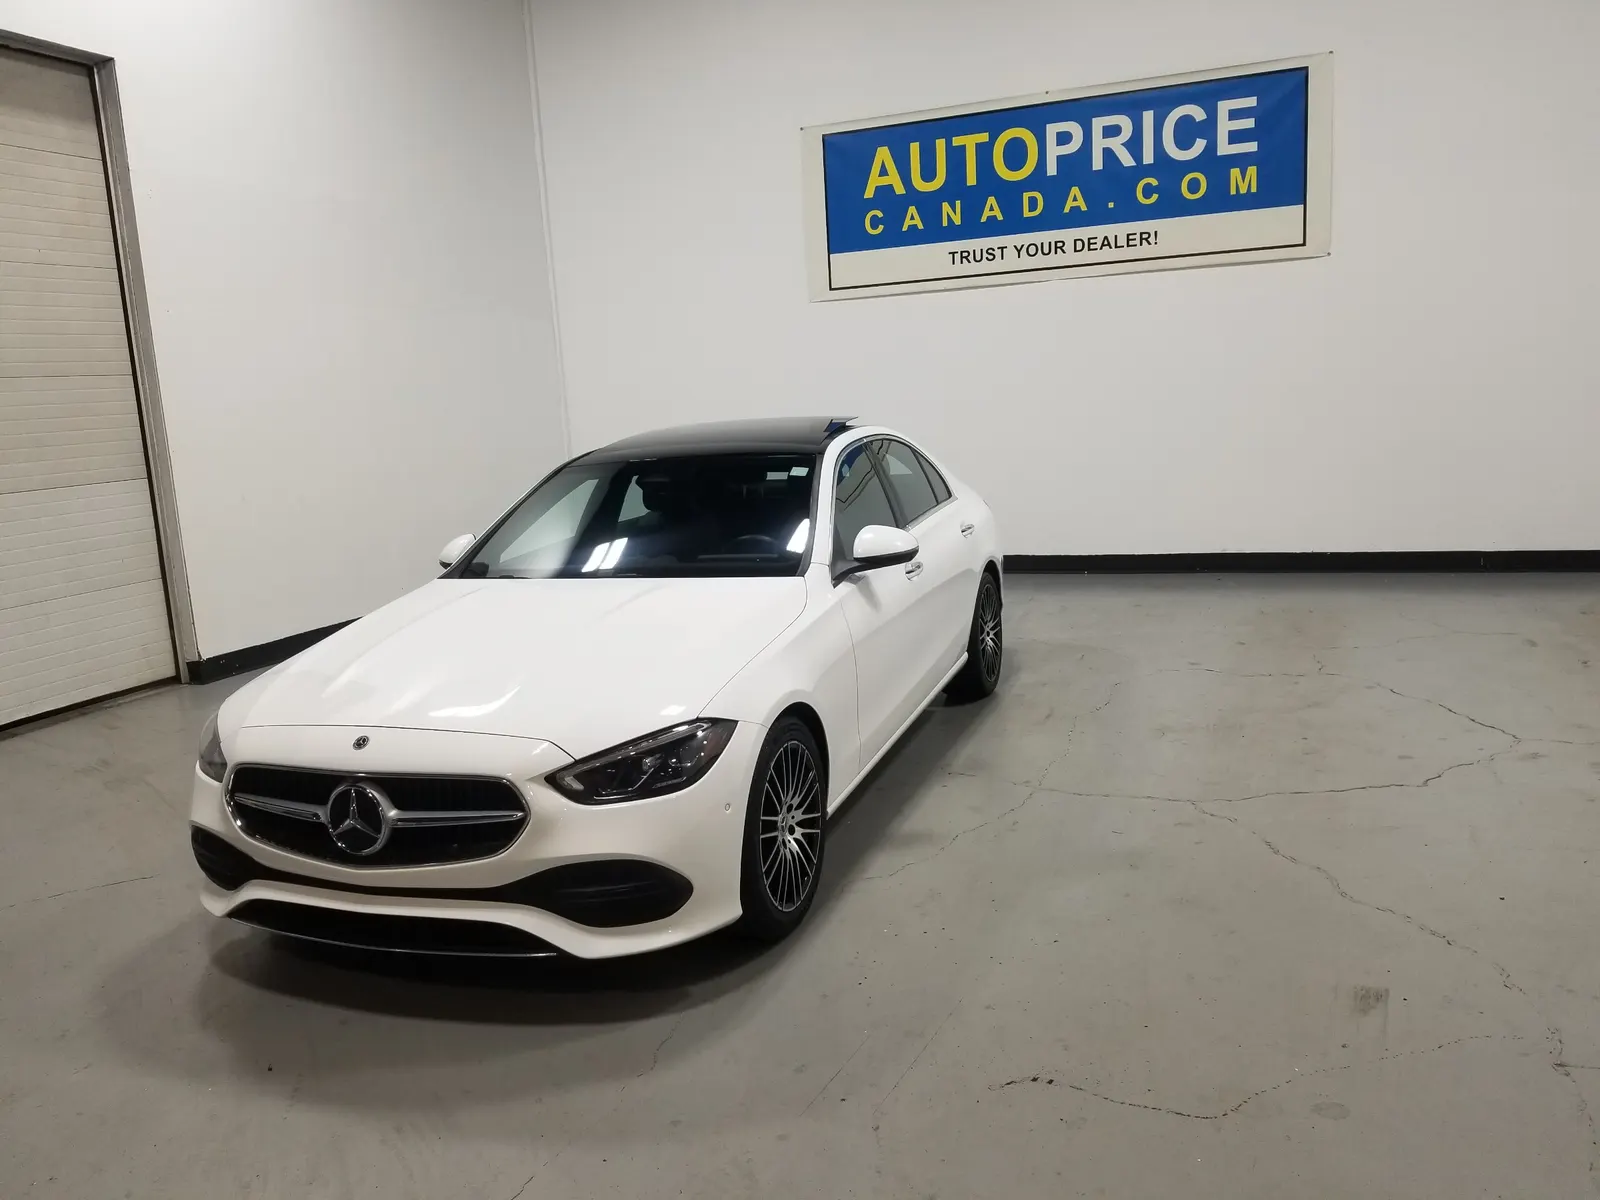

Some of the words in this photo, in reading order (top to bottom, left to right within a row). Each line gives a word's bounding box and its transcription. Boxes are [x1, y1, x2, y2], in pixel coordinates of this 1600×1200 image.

[864, 96, 1258, 198] AUTOPRICE
[864, 166, 1258, 235] CANADA.COM
[949, 246, 1008, 265] TRUST
[1014, 240, 1066, 259] YOUR
[1073, 231, 1159, 253] DEALER!
